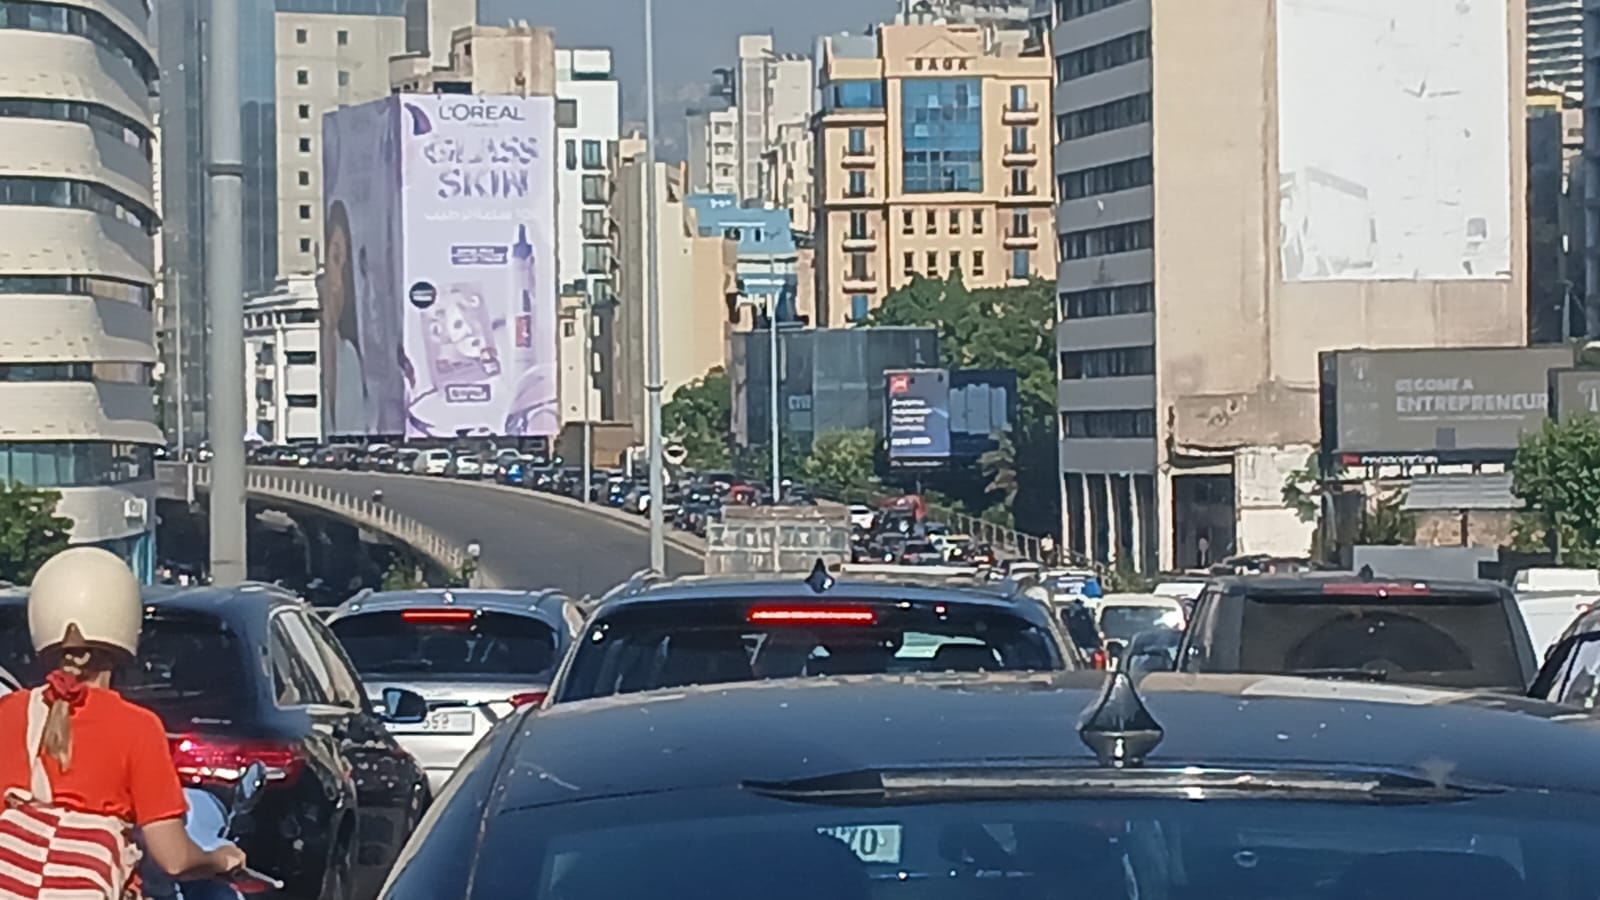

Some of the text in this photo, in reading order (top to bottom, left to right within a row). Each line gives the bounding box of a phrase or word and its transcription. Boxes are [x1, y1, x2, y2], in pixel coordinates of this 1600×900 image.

[438, 169, 528, 198] SKIN
[1396, 378, 1474, 392] BECOME A
[1396, 394, 1548, 413] ENTREPRENEUR
